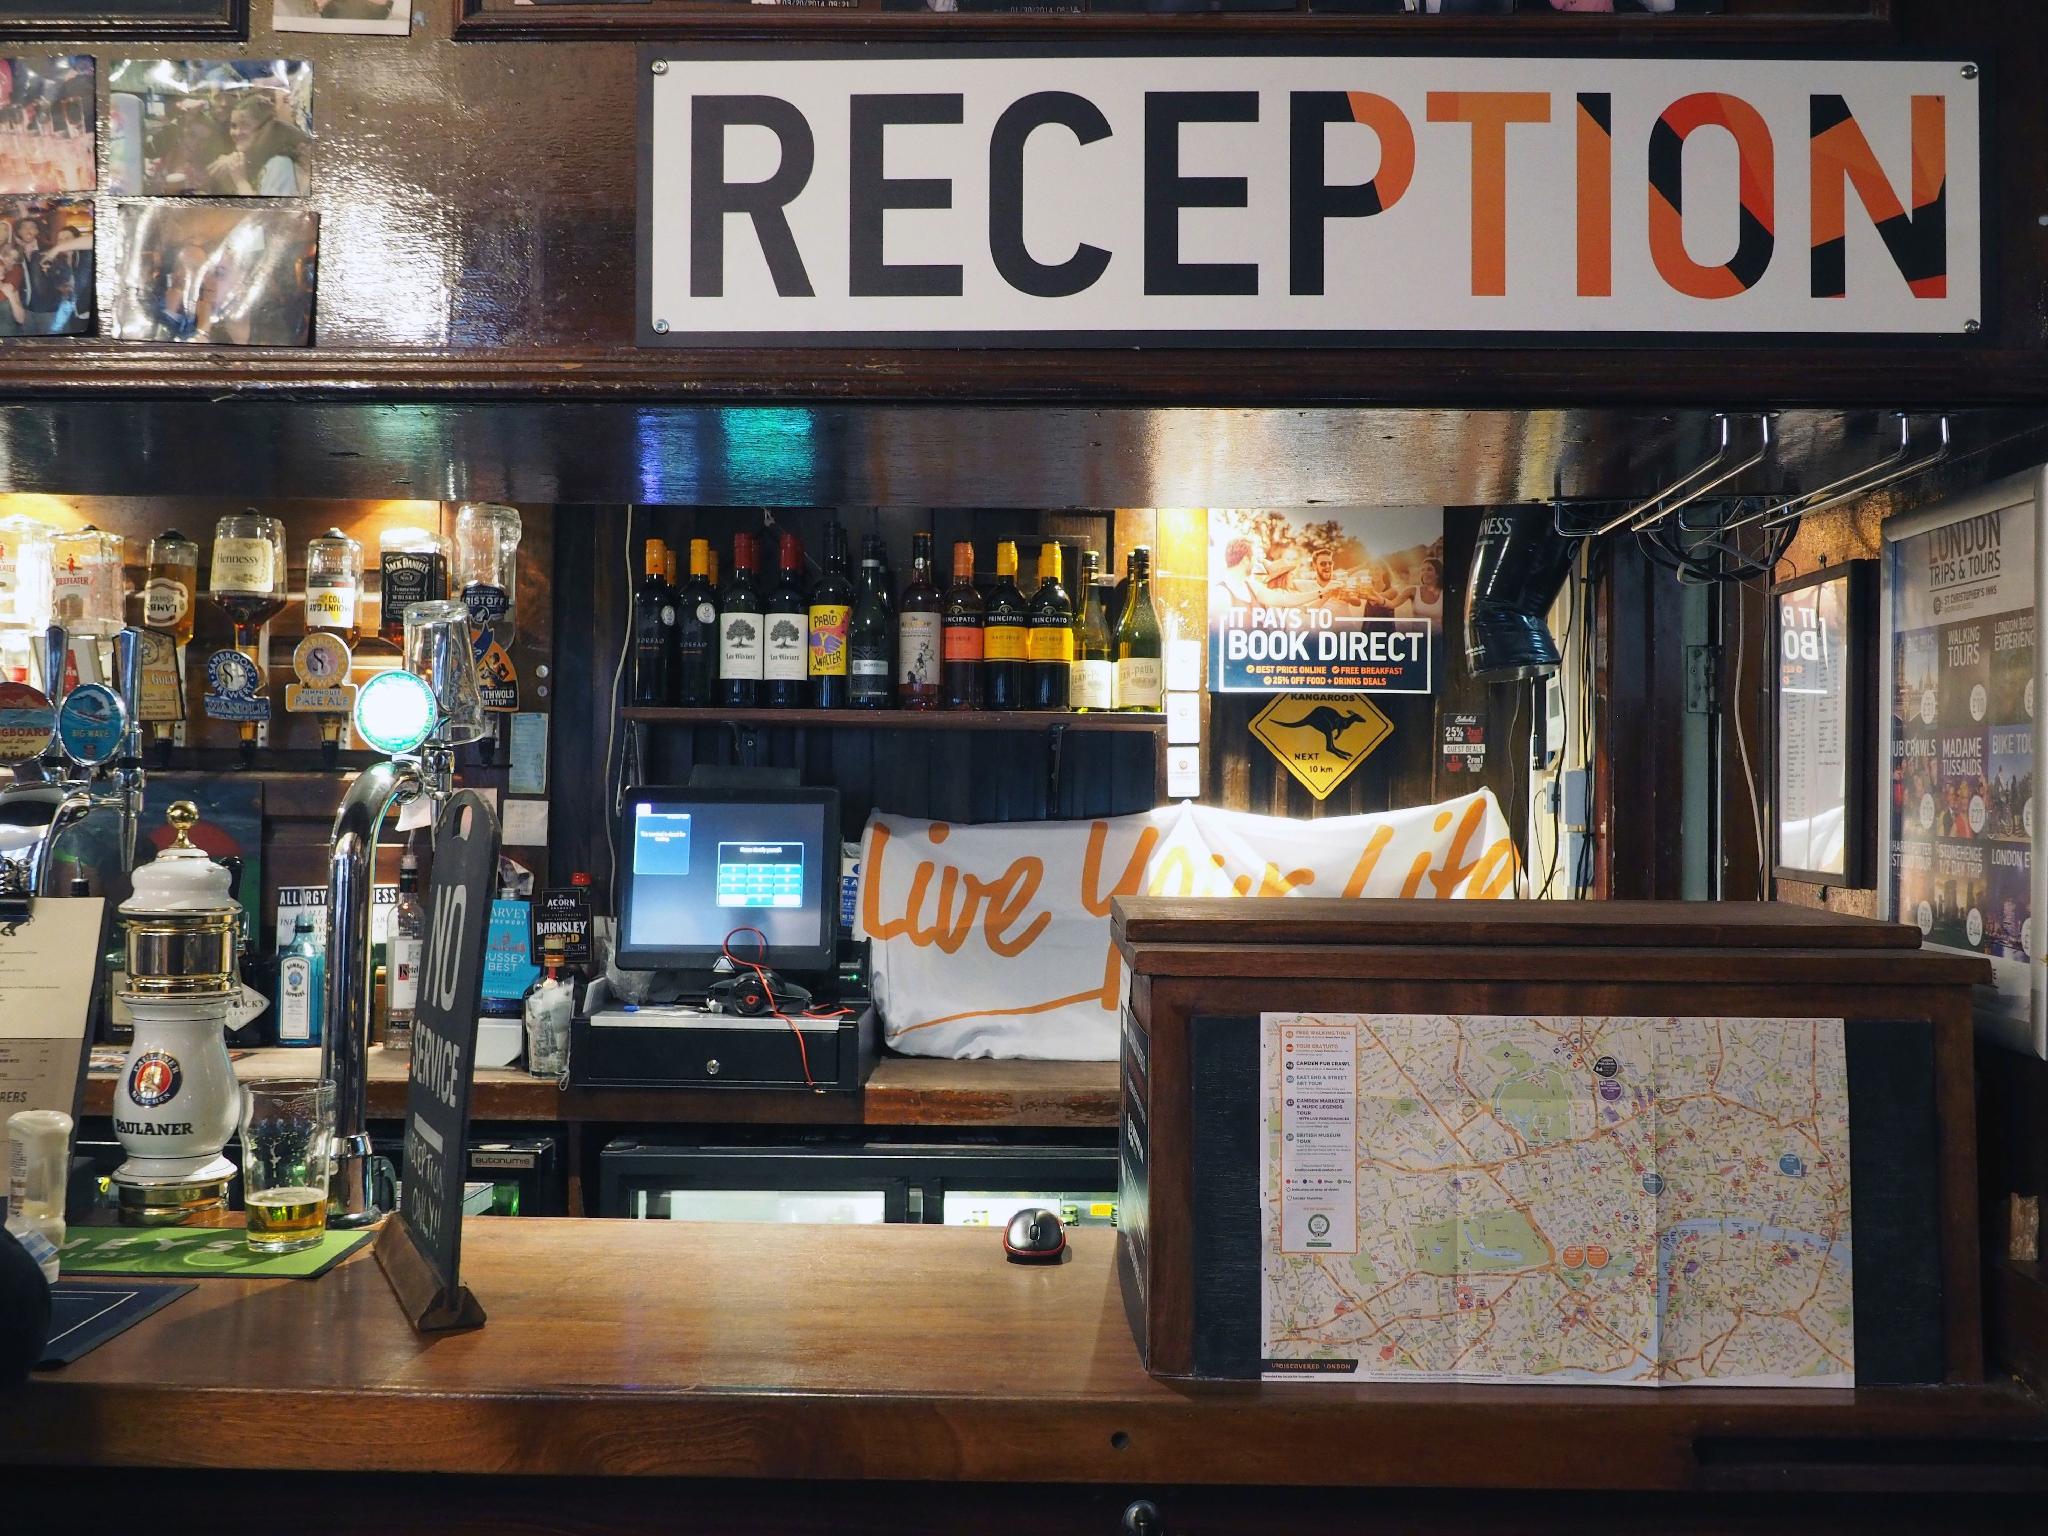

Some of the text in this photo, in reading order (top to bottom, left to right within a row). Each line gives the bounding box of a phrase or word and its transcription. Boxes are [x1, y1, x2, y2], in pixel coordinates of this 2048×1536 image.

[690, 90, 1947, 299] RECEPTION
[217, 552, 259, 566] Hennessy
[385, 560, 403, 574] JACK
[1929, 550, 2001, 587] TRIPS & TOURS
[56, 577, 89, 586] BEEFEATER
[814, 614, 838, 628] PABLO
[1229, 607, 1333, 629] IT PAYS TO
[1994, 619, 2018, 634] LONDON
[1947, 625, 1981, 645] WALKING
[1228, 630, 1424, 662] BOOK DIRECT
[815, 651, 842, 667] WALTER
[1947, 643, 1980, 667] TOURS
[208, 651, 257, 678] SAMBROOK'S
[1256, 665, 1404, 675] BEST PRICE ONLINE FREE BREAKFAST
[1272, 676, 1290, 685] 25%
[1290, 676, 1305, 685] OFF
[1306, 676, 1326, 685] FOOD
[1333, 677, 1362, 686] DRINKS
[1362, 677, 1387, 686] DEALS
[296, 696, 349, 706] PALE ALE
[1290, 692, 1356, 702] KANGAROOS
[206, 700, 268, 712] WANDLE
[1445, 726, 1464, 737] 25%
[1446, 745, 1465, 753] GUEST
[1906, 738, 1937, 757] CRAWLS
[1942, 737, 1983, 758] MADAME
[1992, 733, 2014, 755] BIKE
[1294, 753, 1320, 761] NEXT
[1320, 765, 1334, 773] km
[1942, 758, 1983, 776] TUSSAUDS
[1992, 849, 2023, 866] LONDON
[862, 820, 1051, 958] Live
[547, 899, 576, 907] ACORN
[536, 922, 588, 935] BARNSLEY
[424, 884, 468, 1013] NO
[488, 963, 517, 972] BEST
[411, 1019, 461, 1109] SERVICE
[114, 1118, 195, 1137] PAULANER
